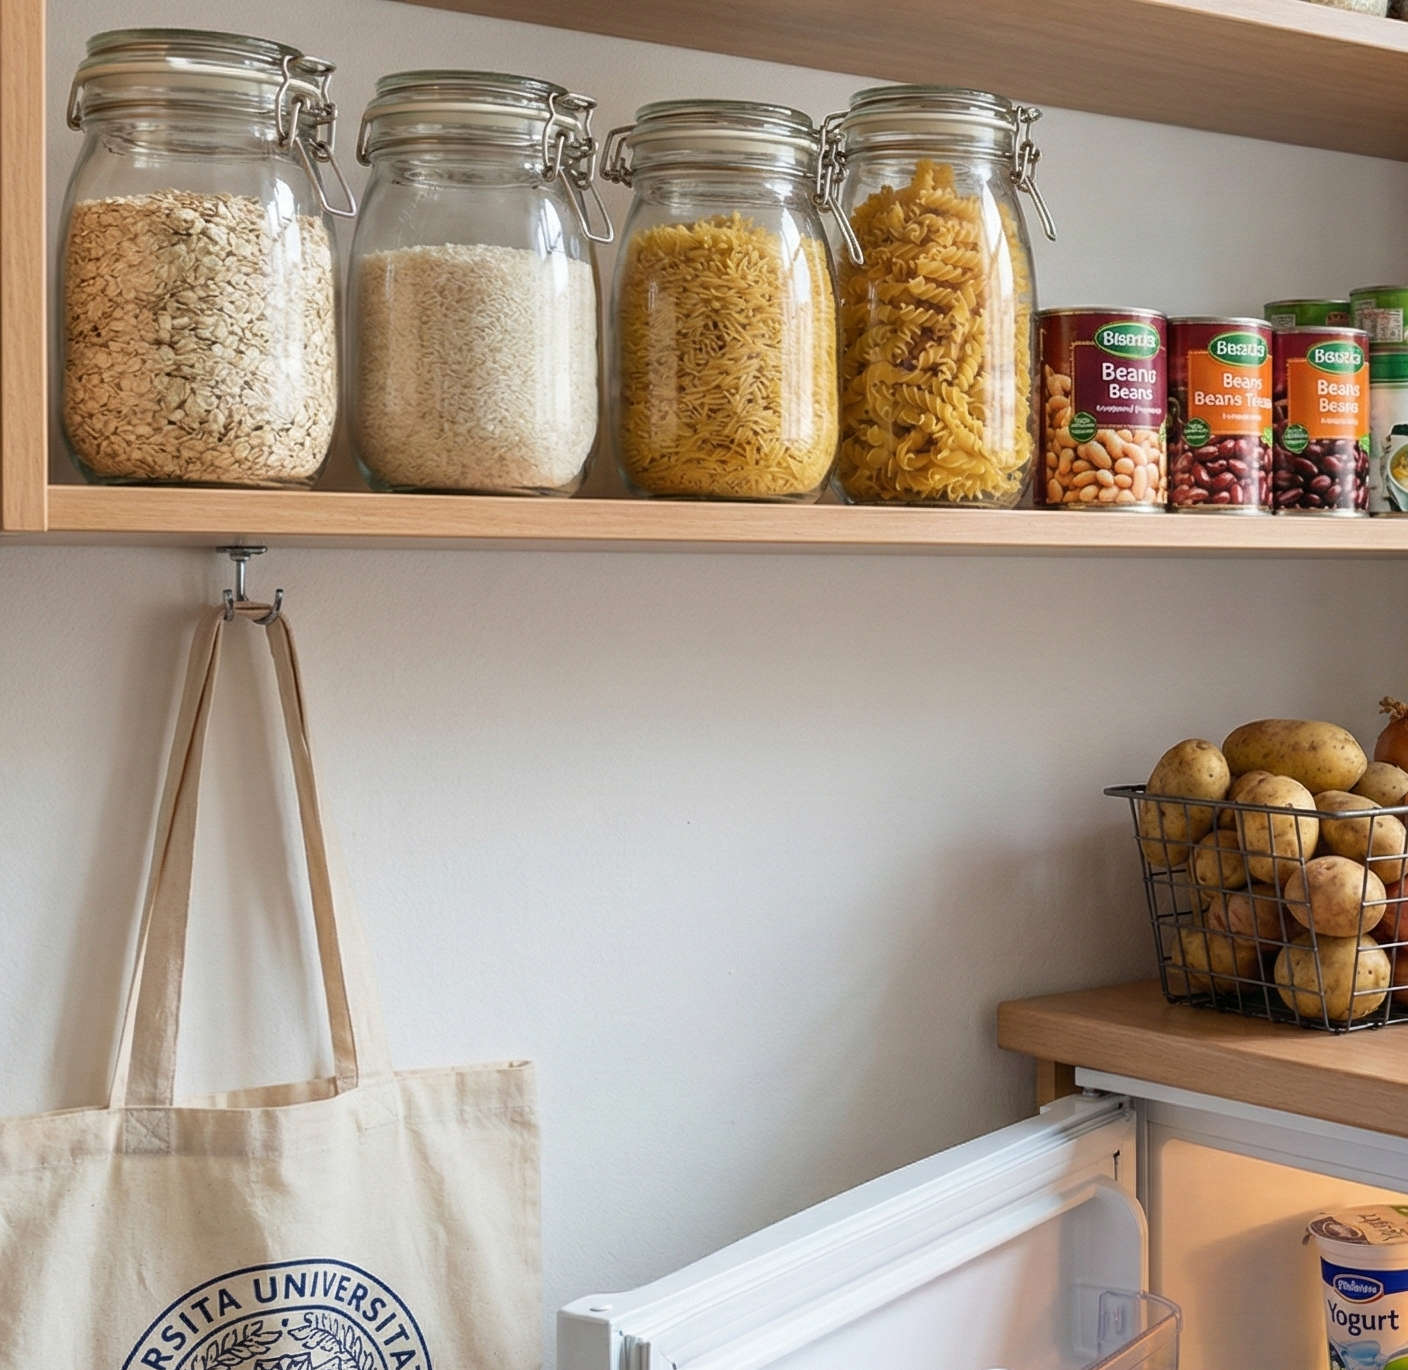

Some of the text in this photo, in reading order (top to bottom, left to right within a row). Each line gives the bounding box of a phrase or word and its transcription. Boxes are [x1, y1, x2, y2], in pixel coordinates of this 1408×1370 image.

[1109, 384, 1153, 400] Beans
[1194, 391, 1242, 406] Beans
[253, 1271, 421, 1370] UNIVERSITA
[1327, 1299, 1400, 1337] Yogurt
